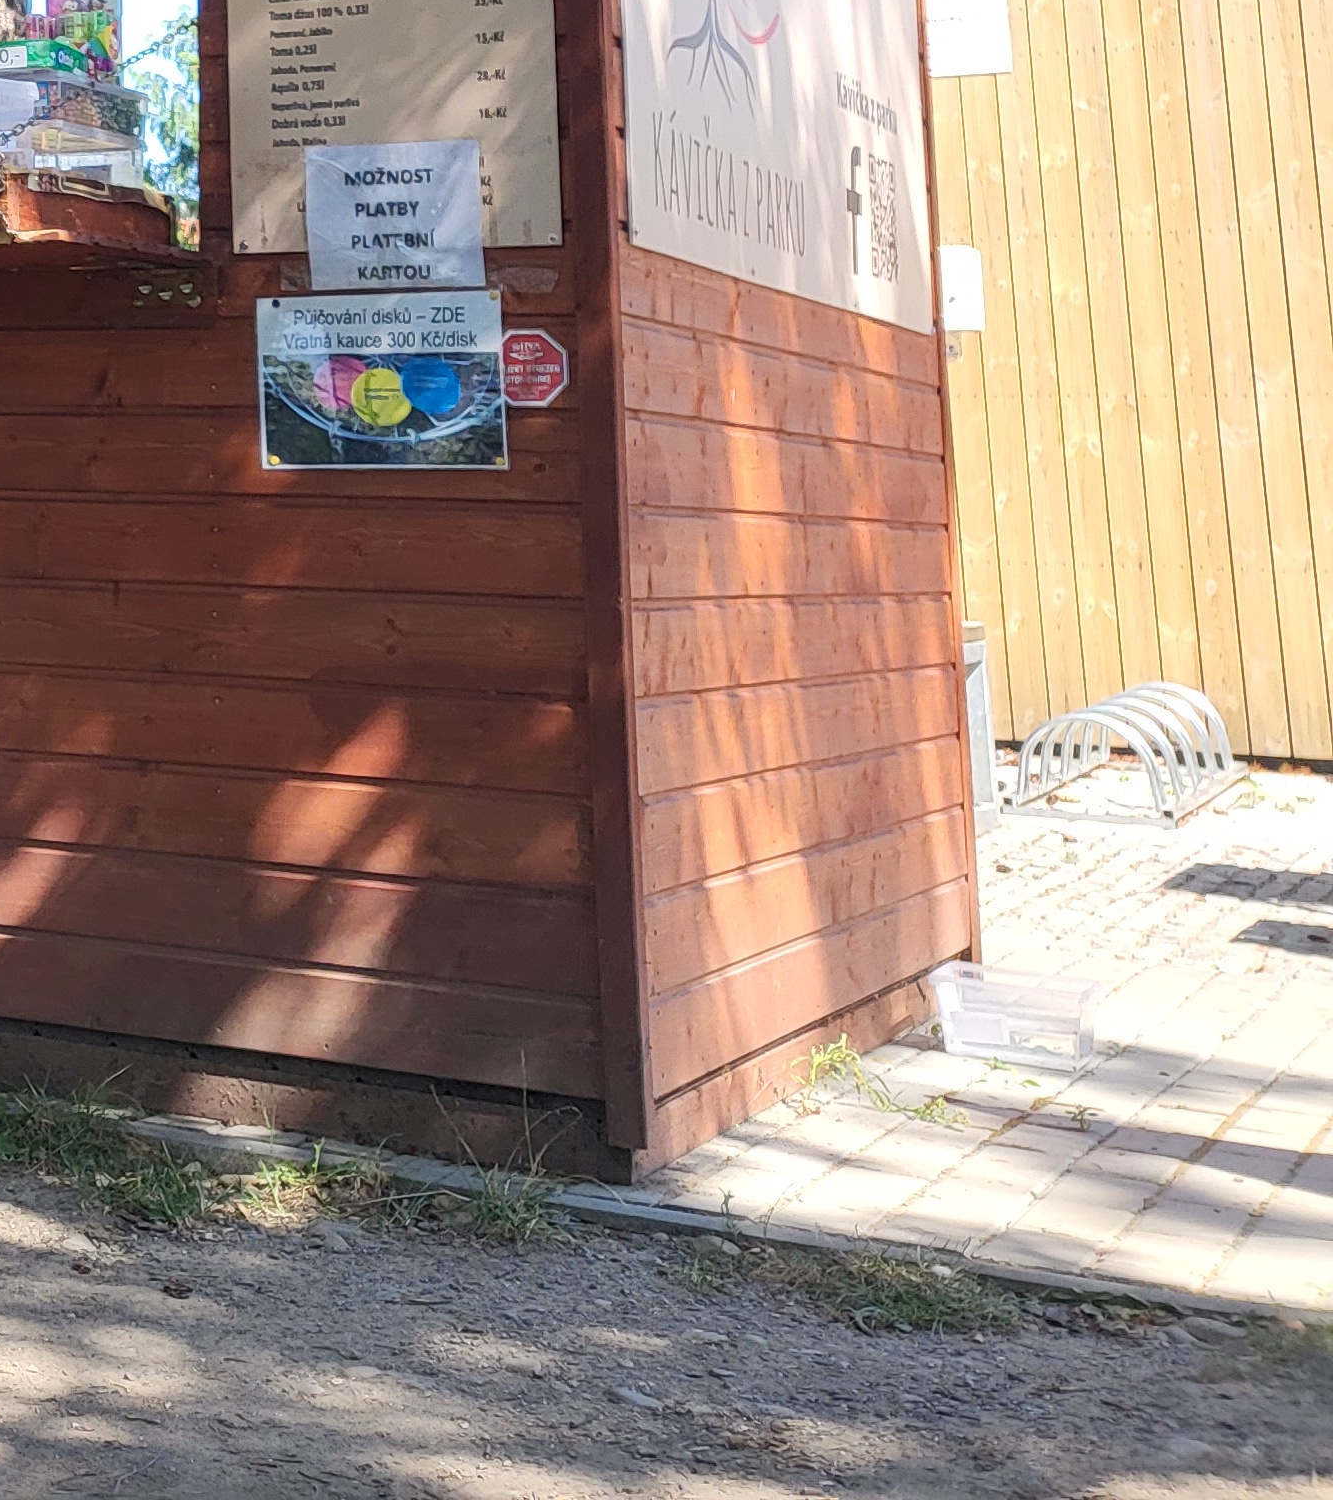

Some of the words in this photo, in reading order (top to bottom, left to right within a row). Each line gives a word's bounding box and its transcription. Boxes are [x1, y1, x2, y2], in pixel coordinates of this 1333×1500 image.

[344, 166, 434, 186] MOŽNOST
[652, 109, 738, 236] KÁVIČKA
[743, 160, 750, 238] Z
[756, 165, 806, 257] PARKU
[355, 201, 420, 218] PLATBY
[351, 228, 436, 249] PLATEBNÍ
[357, 265, 431, 281] KARTOU
[293, 308, 367, 326] Půjčování
[371, 304, 413, 325] disků
[430, 306, 466, 324] ZDE
[284, 333, 333, 350] Vratná
[337, 333, 383, 349] kauce
[387, 332, 416, 348] 300
[421, 328, 478, 349] Kč/disk
